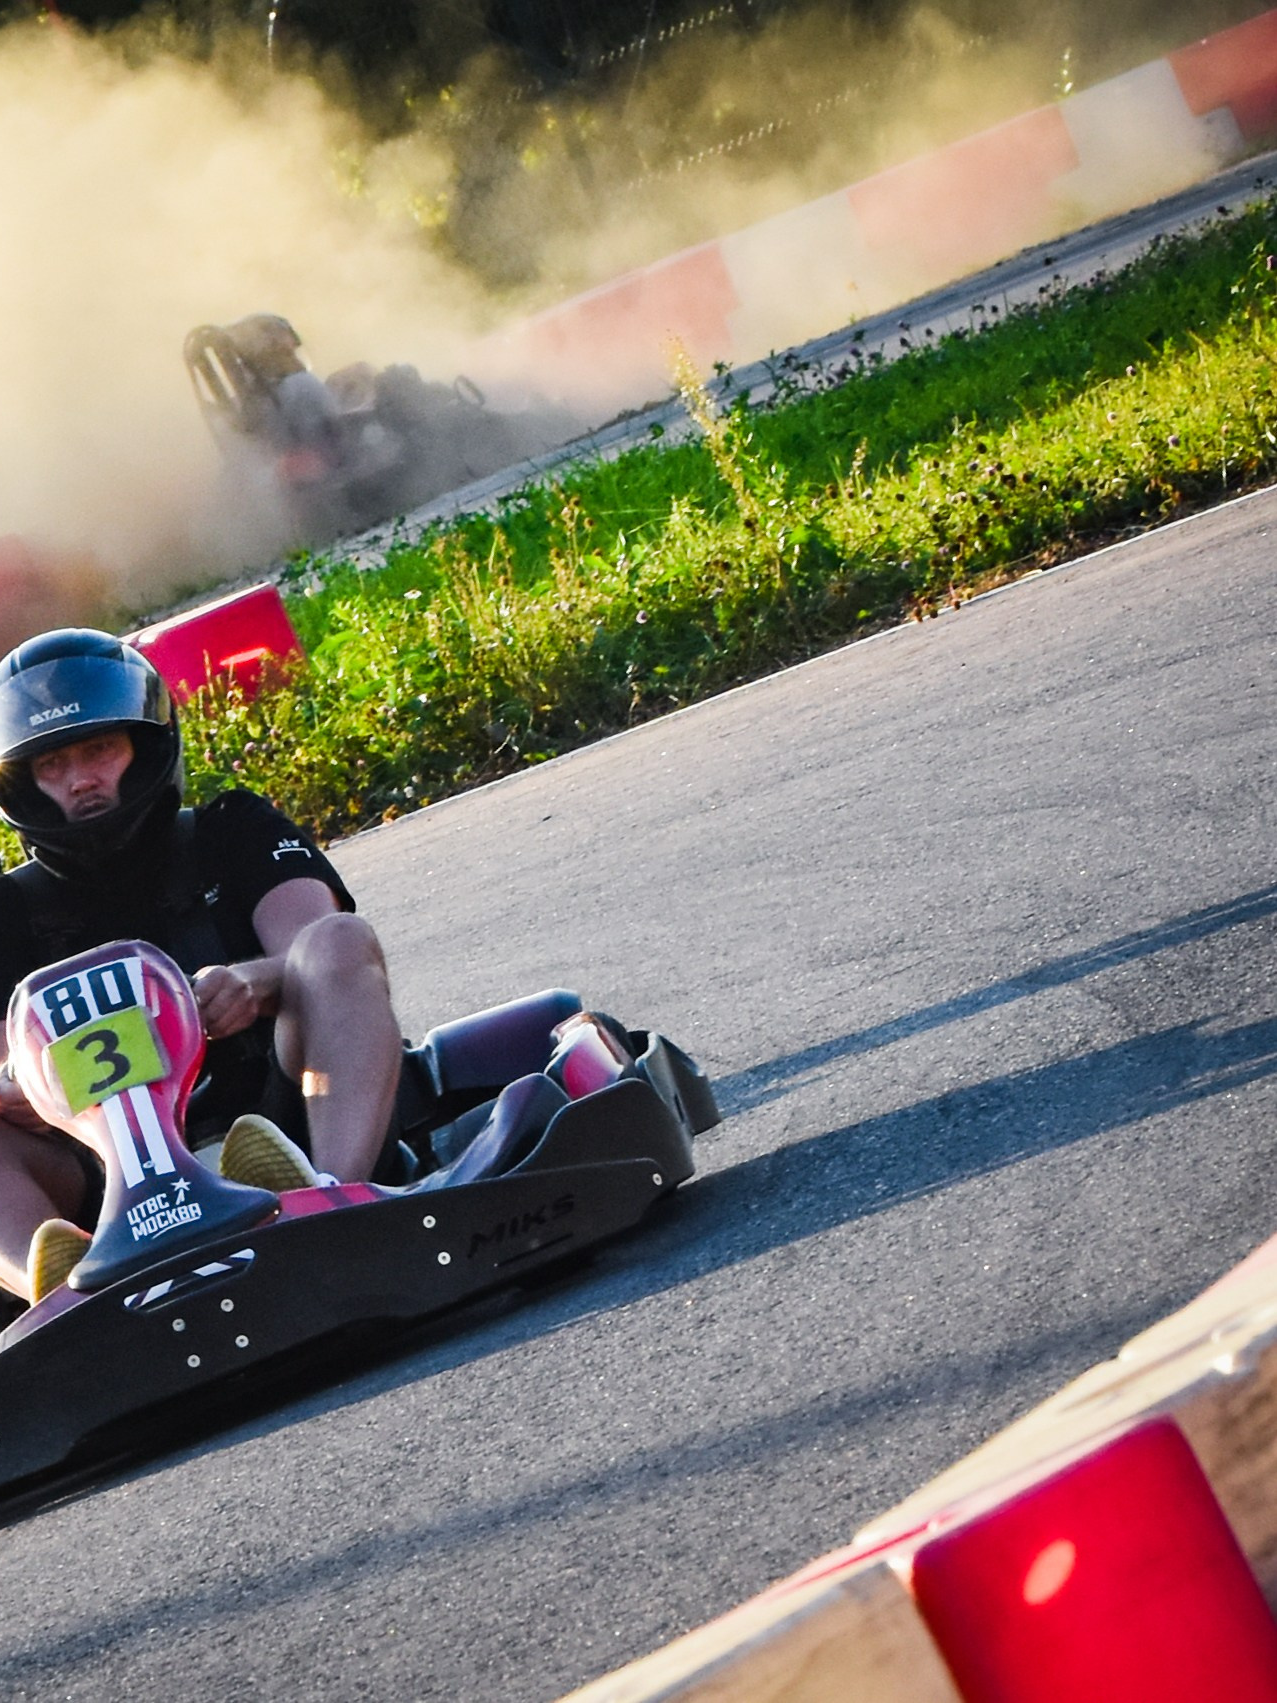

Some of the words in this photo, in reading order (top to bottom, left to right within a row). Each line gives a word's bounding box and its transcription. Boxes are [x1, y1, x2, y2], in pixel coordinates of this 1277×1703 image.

[42, 962, 137, 1037] 80
[75, 1029, 131, 1094] 3
[131, 1202, 202, 1241] МОСКВА
[467, 1194, 574, 1258] MIKS
